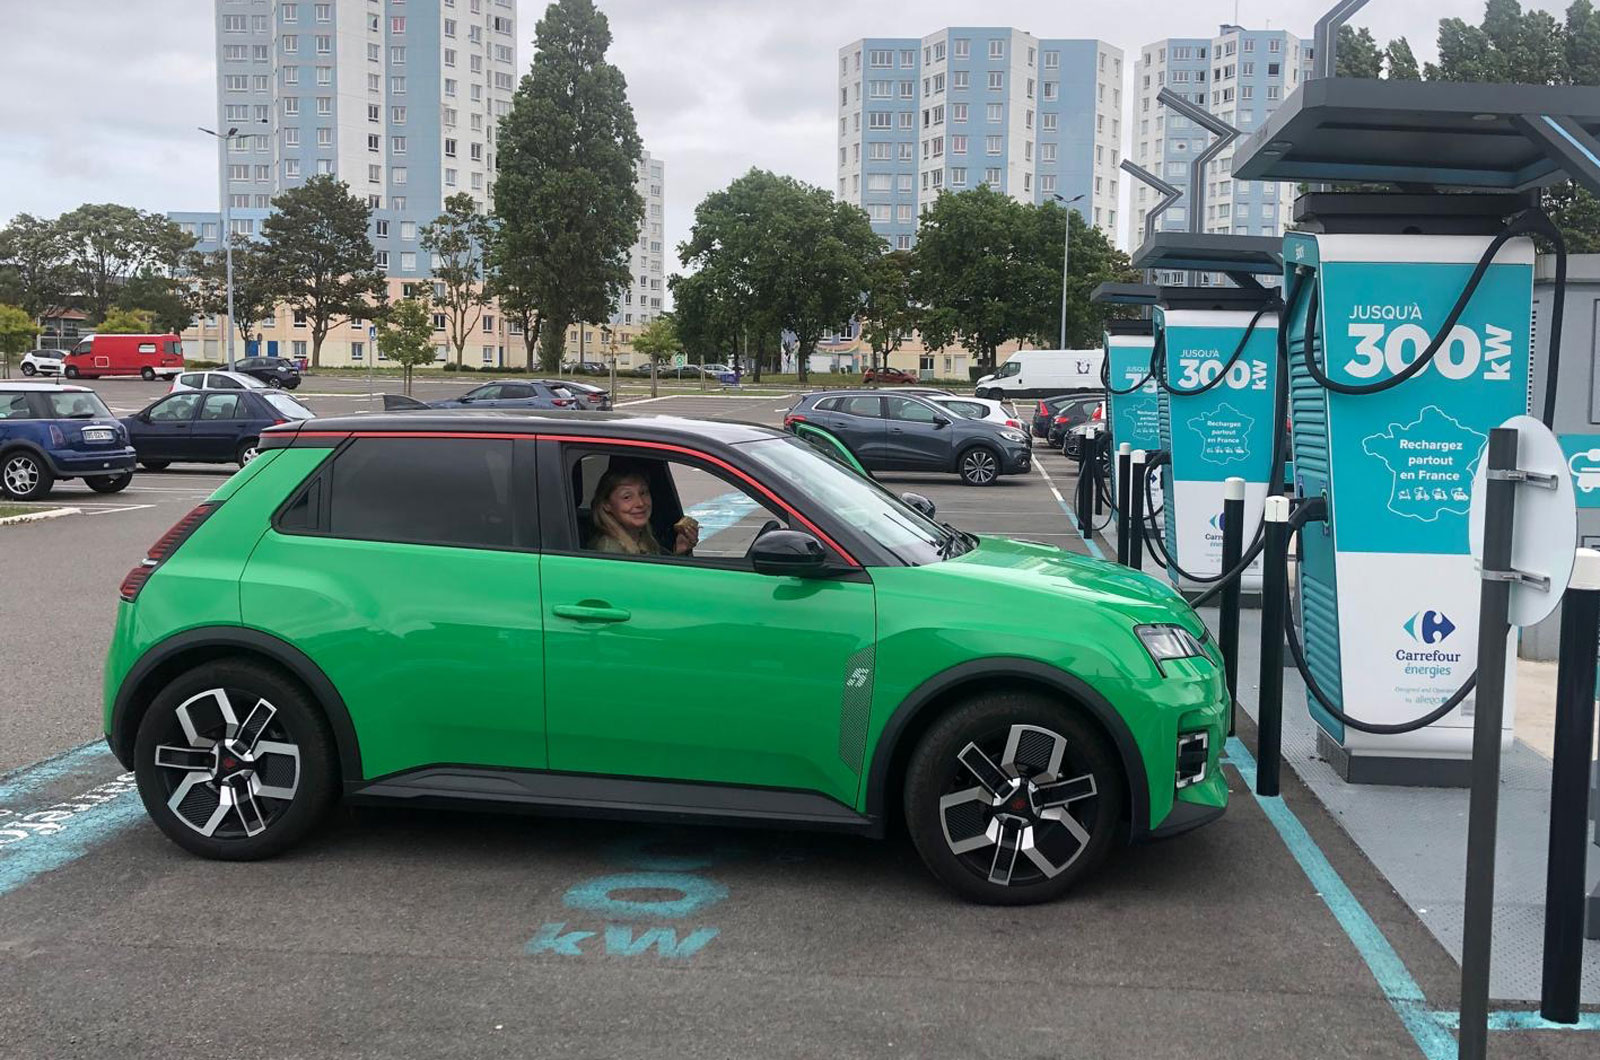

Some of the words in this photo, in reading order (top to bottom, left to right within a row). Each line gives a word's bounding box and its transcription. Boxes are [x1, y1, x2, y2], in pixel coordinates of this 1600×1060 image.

[1349, 302, 1423, 320] JUSQU'À
[1344, 323, 1481, 380] 300
[1483, 323, 1513, 380] kW
[1178, 359, 1251, 389] 300
[1400, 439, 1463, 452] Rechargez
[1408, 456, 1454, 467] partout
[1400, 471, 1415, 480] en
[1418, 470, 1460, 481] France
[1396, 649, 1462, 662] Carrefour
[1404, 662, 1451, 679] énergies
[524, 922, 721, 958] kW
